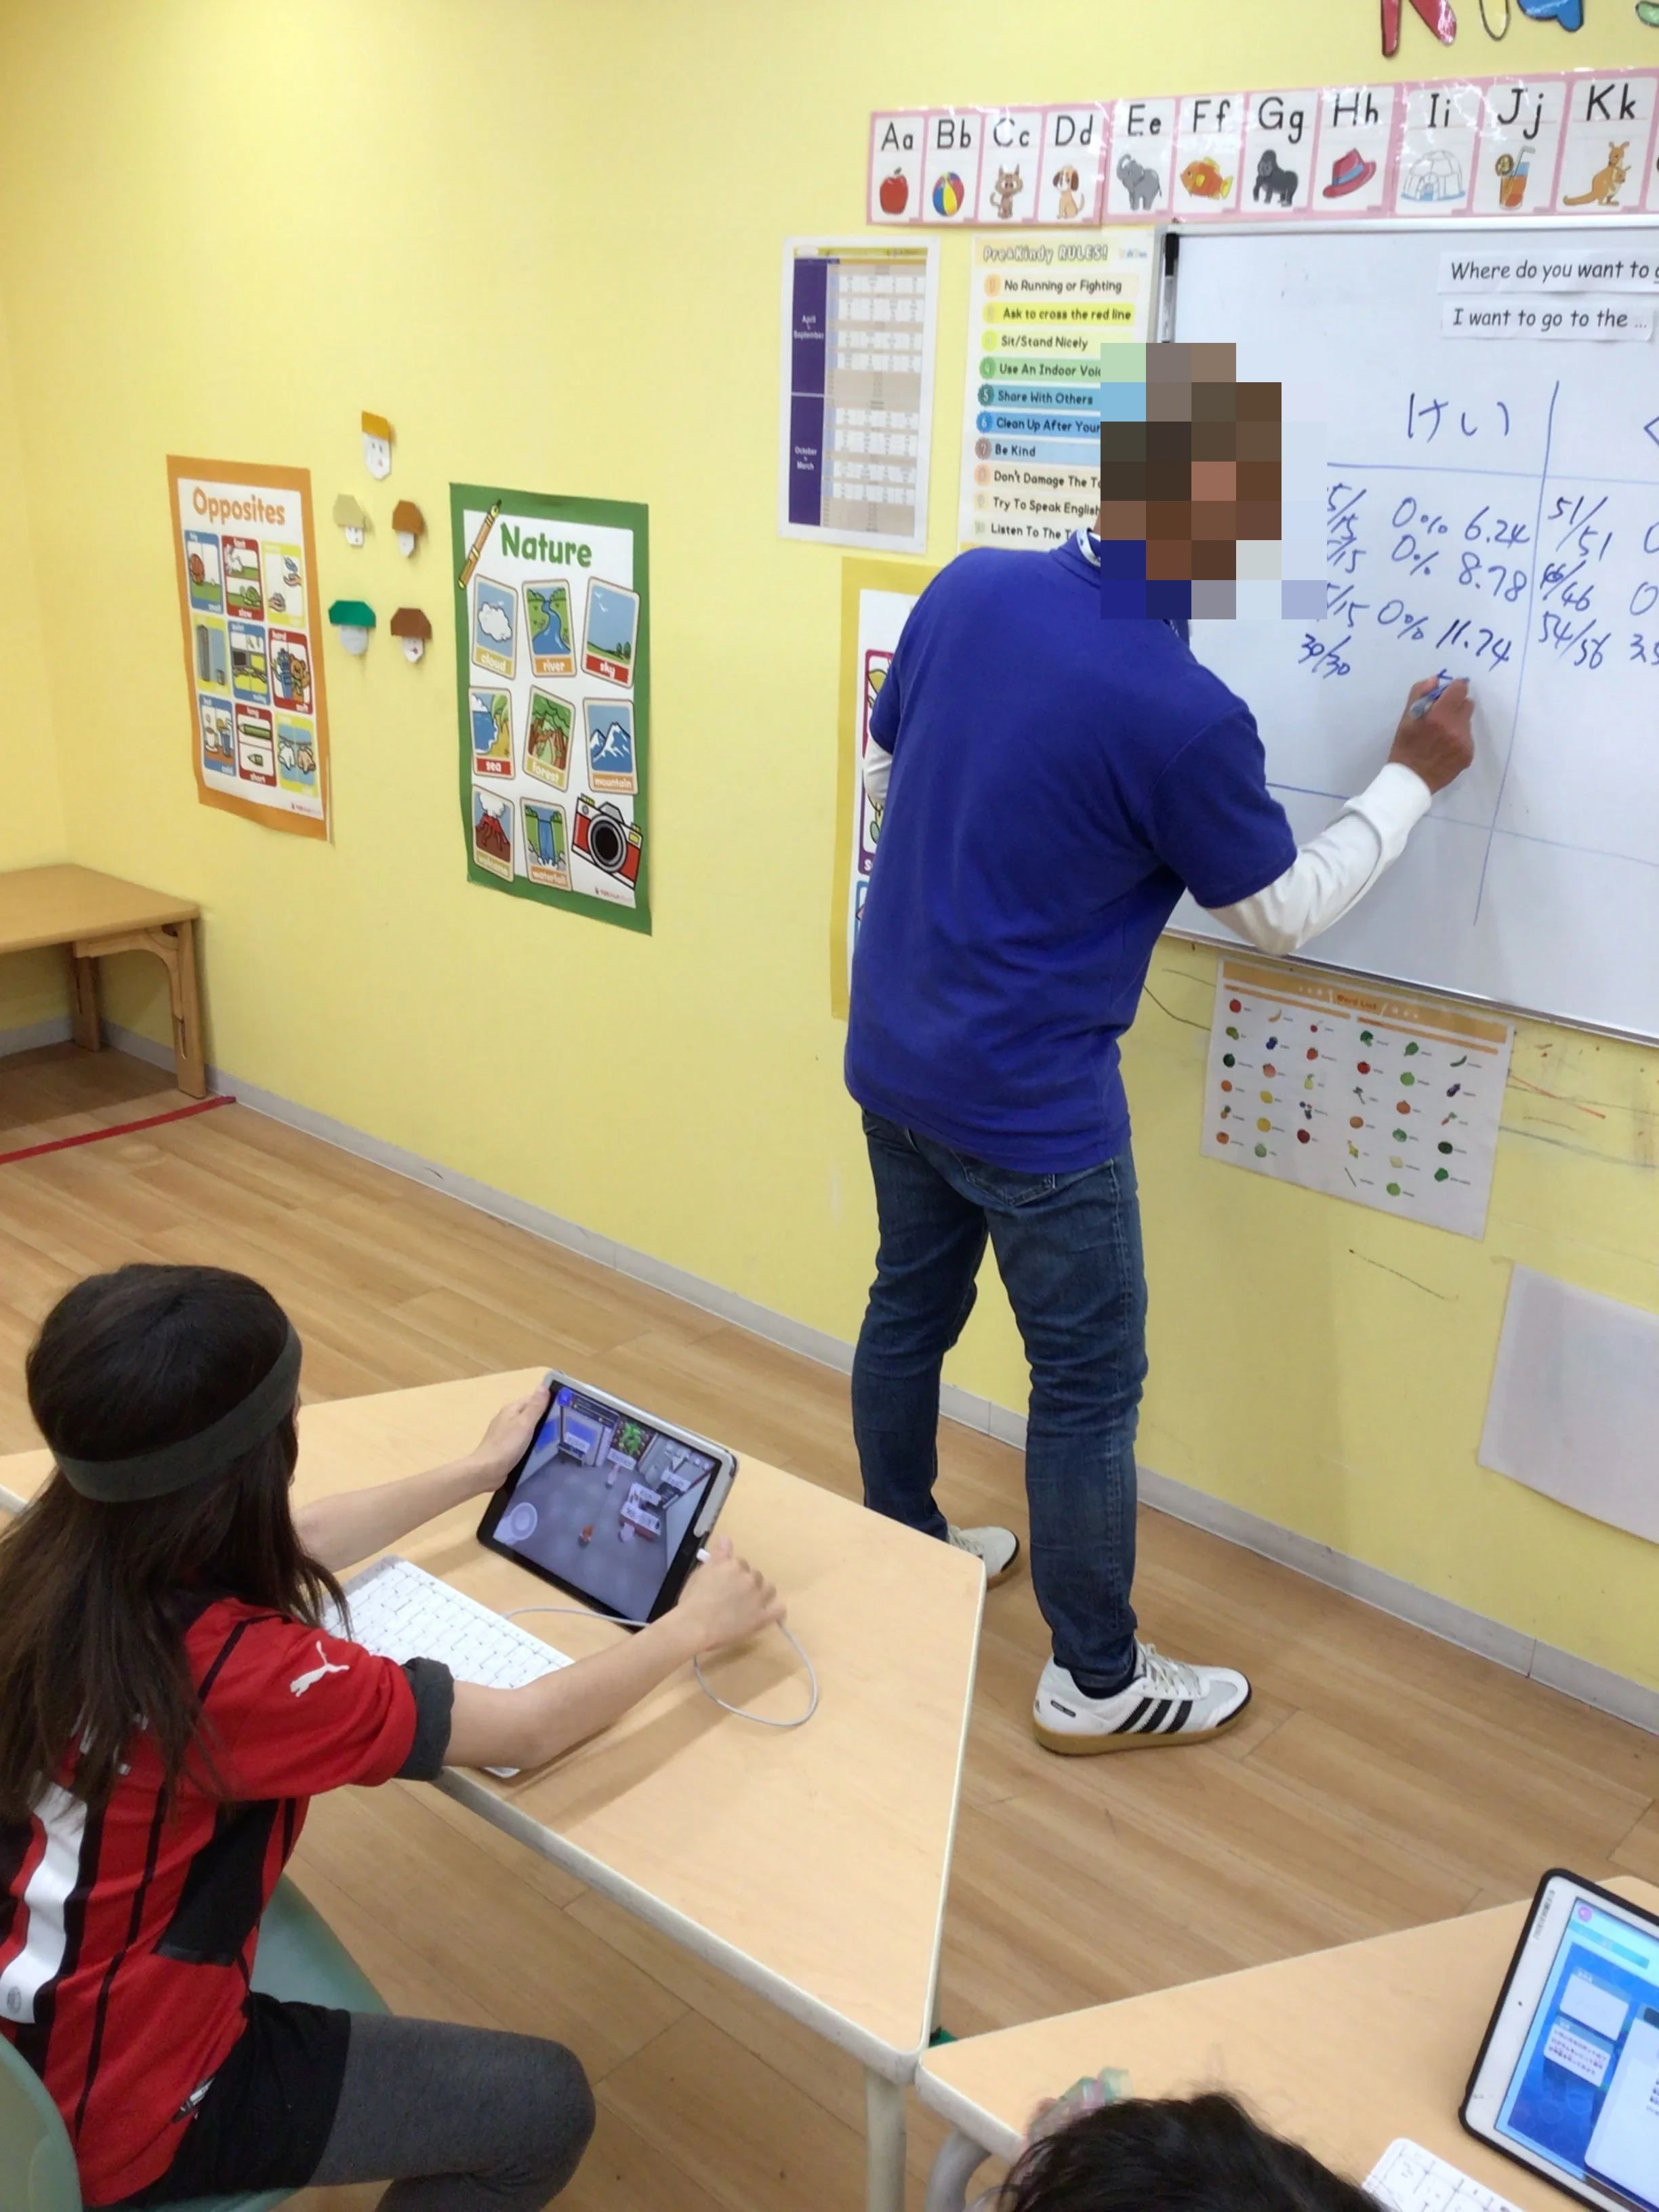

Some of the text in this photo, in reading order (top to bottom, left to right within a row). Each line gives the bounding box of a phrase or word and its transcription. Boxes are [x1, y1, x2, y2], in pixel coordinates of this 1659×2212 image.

[881, 82, 1637, 151] Aa Bb Cc Dd Ee Ff Gg Hh Ii Jj Kk
[1058, 243, 1109, 262] RULES!
[1450, 261, 1511, 281] Where
[1515, 260, 1537, 279] do
[1542, 263, 1572, 283] you
[1578, 260, 1624, 279] want
[1629, 260, 1650, 279] to
[1004, 280, 1019, 291] No
[1021, 280, 1063, 295] Running
[1065, 282, 1077, 291] or
[1080, 280, 1123, 295] Fighting
[1002, 307, 1022, 321] Ask
[1025, 308, 1036, 320] to
[1038, 310, 1068, 321] cross
[1070, 308, 1088, 321] the
[1090, 308, 1109, 321] red
[1111, 308, 1132, 321] line
[1453, 308, 1464, 326] I
[1469, 309, 1511, 327] want
[1518, 309, 1536, 327] to
[1541, 313, 1563, 332] go
[1570, 310, 1590, 327] to
[1597, 308, 1628, 328] the
[1001, 334, 1052, 348] Sit/Stand
[1055, 336, 1088, 351] Nicely
[999, 363, 1019, 375] Use
[1021, 363, 1036, 375] An
[1039, 364, 1076, 377] Indoor
[998, 390, 1028, 403] Share
[1030, 392, 1052, 403] With
[1055, 393, 1093, 405] Others
[996, 417, 1025, 430] Clean
[1027, 419, 1040, 433] Up
[1043, 419, 1072, 432] After
[995, 443, 1008, 455] Be
[1011, 444, 1036, 457] Kind
[994, 470, 1021, 483] Don't
[1023, 472, 1065, 489] Damage
[1068, 476, 1087, 488] The
[192, 485, 286, 526] Opposites
[993, 496, 1010, 512] Try
[1014, 498, 1027, 510] To
[1029, 500, 1061, 514] Speak
[991, 523, 1023, 536] Listen
[1026, 525, 1039, 537] To
[1042, 528, 1061, 540] The
[1464, 505, 1531, 550] 6.24
[500, 522, 592, 569] Nature
[1458, 551, 1528, 602] 8.78
[1377, 599, 1429, 640] 0%
[480, 653, 506, 671] cloud
[1298, 633, 1351, 679] 30/30
[543, 660, 566, 672] river
[600, 661, 615, 678] sky
[486, 760, 502, 773] sea
[532, 761, 560, 784] forest
[594, 777, 633, 790] mountain
